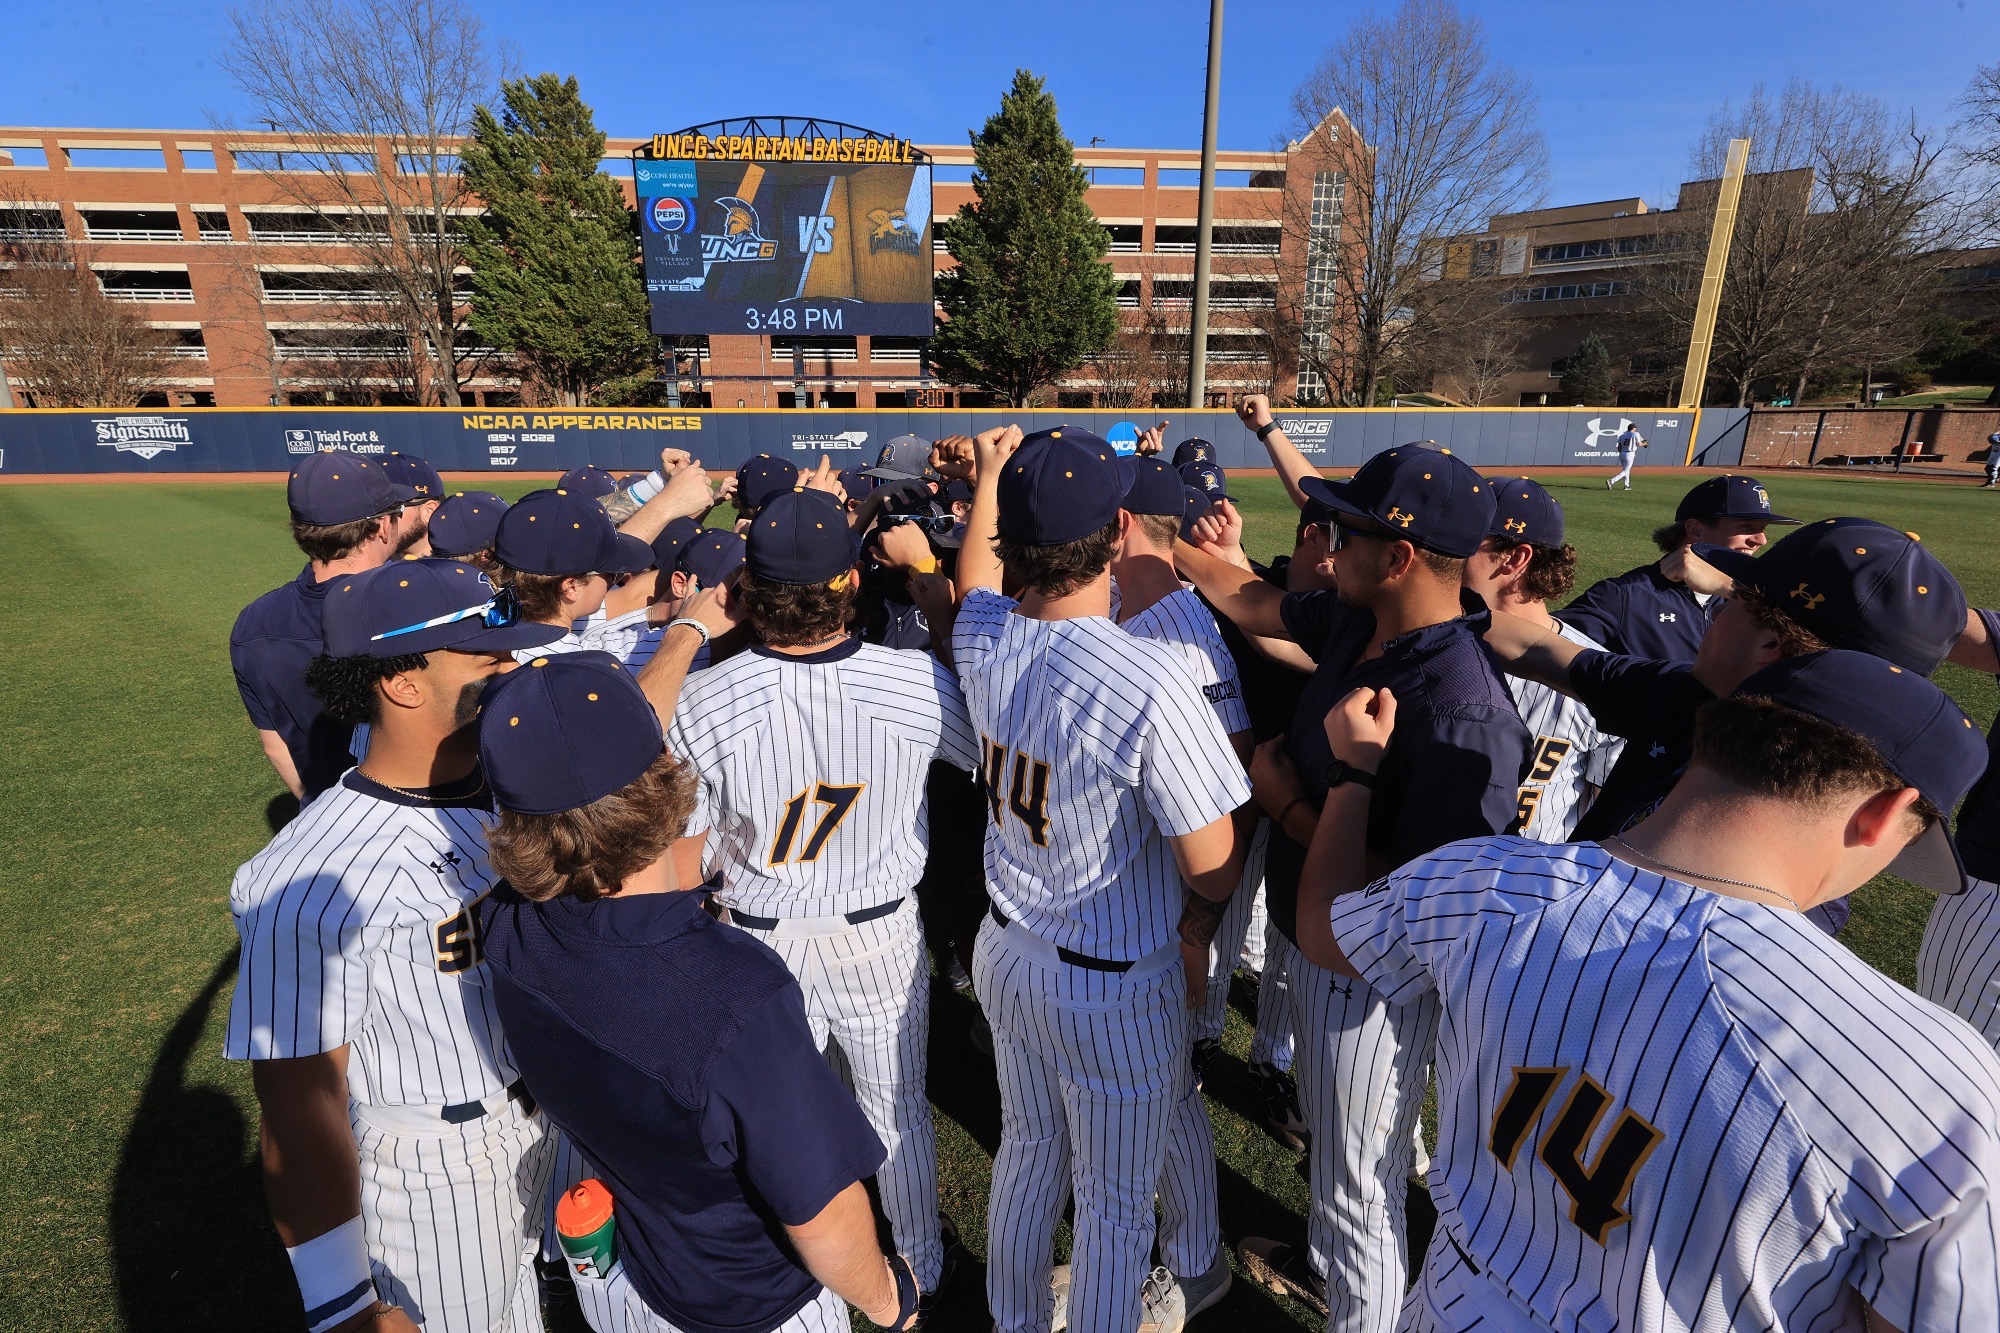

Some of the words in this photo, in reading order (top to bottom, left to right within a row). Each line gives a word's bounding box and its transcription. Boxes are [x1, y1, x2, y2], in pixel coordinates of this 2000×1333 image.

[652, 134, 709, 159] UNCG
[714, 136, 807, 162] SPARTAN
[812, 138, 914, 164] BASEBALL
[656, 210, 684, 219] PEPSI
[799, 216, 835, 254] VS
[701, 239, 777, 259] UNCG
[646, 284, 702, 292] STEEL
[746, 308, 797, 330] 3:48
[804, 308, 843, 330] PM
[118, 418, 130, 426] THE
[131, 417, 163, 425] CAROLINA
[463, 415, 528, 430] NCAA
[532, 415, 702, 431] APPEARANCES
[1282, 420, 1332, 435] UNCG
[1656, 420, 1679, 428] 340
[96, 422, 190, 443] Signsmith
[313, 430, 341, 442] Triad
[343, 430, 368, 442] Foot
[369, 430, 379, 442] &
[487, 434, 515, 442] 1994
[521, 434, 556, 443] 2022
[350, 442, 386, 454] Center
[489, 445, 517, 454] 1997
[791, 440, 862, 450] STEEL
[1111, 440, 1138, 451] NCA
[490, 457, 518, 466] 2017
[980, 731, 1052, 848] 44
[766, 780, 867, 868] 17
[1487, 1065, 1666, 1249] 14
